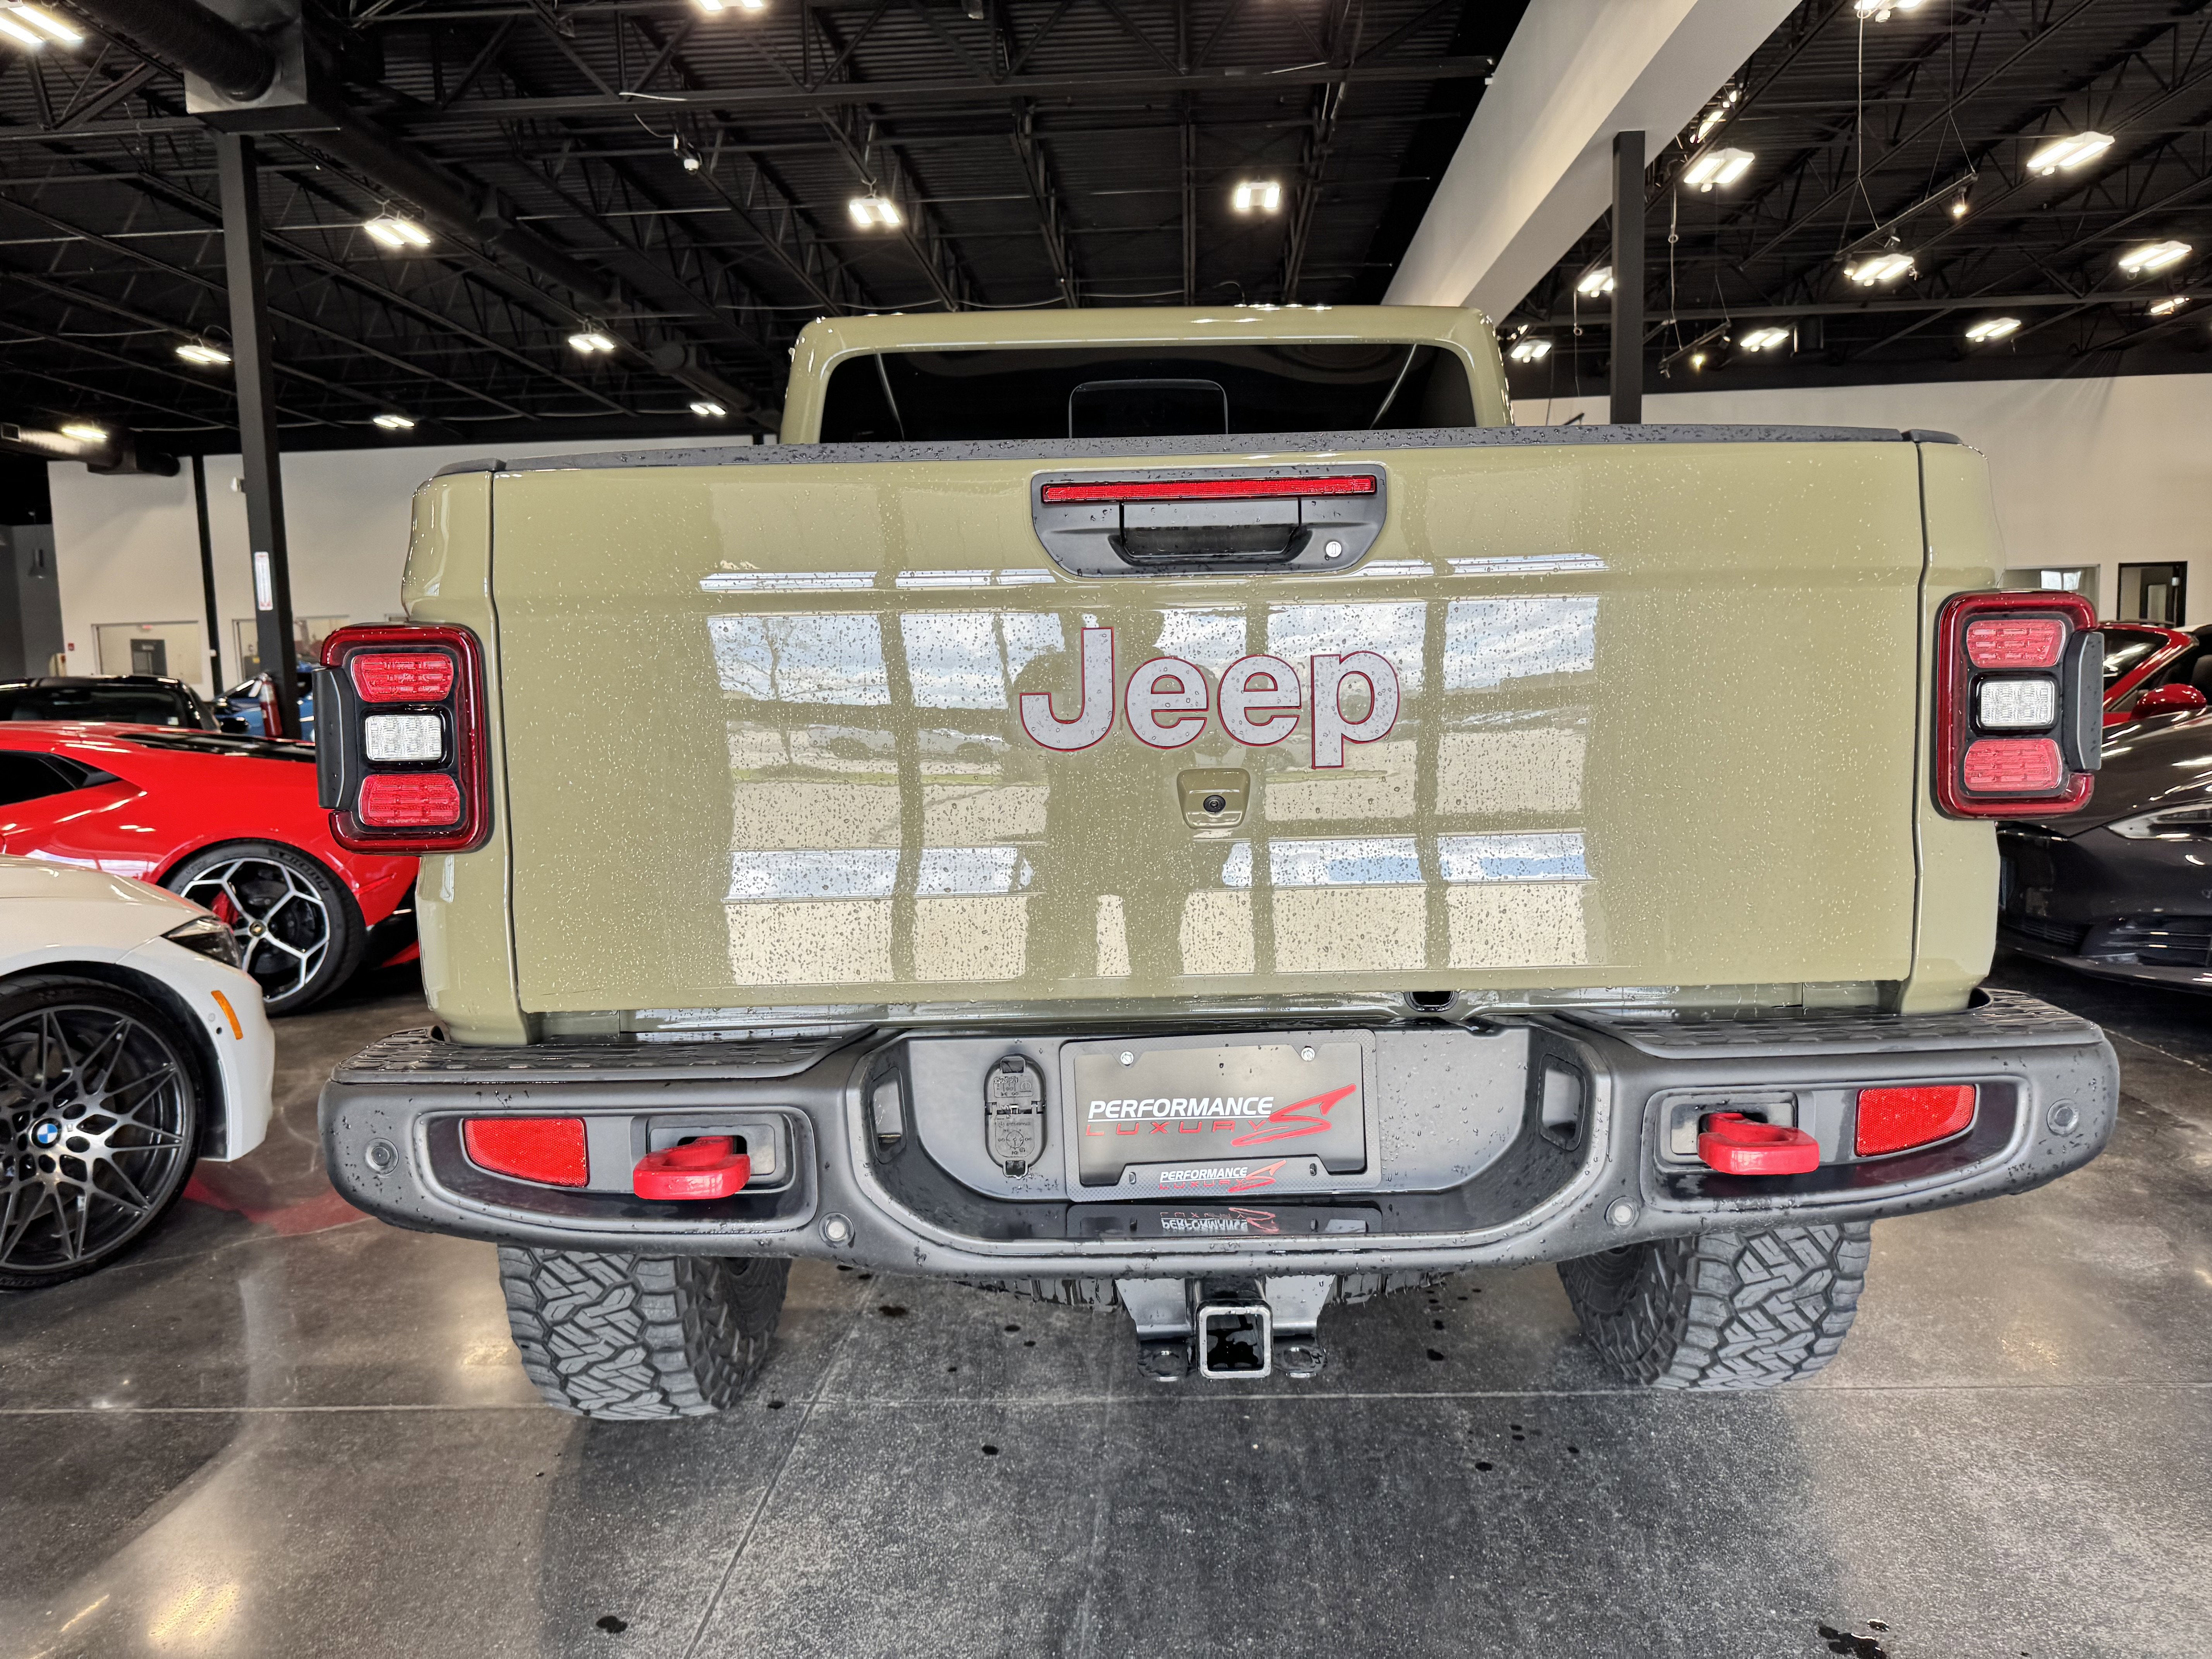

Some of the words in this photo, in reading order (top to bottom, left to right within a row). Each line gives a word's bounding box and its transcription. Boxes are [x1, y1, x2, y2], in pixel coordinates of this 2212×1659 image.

[1020, 627, 1400, 769] Jeep
[1088, 1096, 1274, 1119] PERFORMANCE
[1085, 1120, 1267, 1136] LUXURY
[1160, 1167, 1248, 1181] PERFORMANCE
[1159, 1179, 1245, 1190] LUXURY
